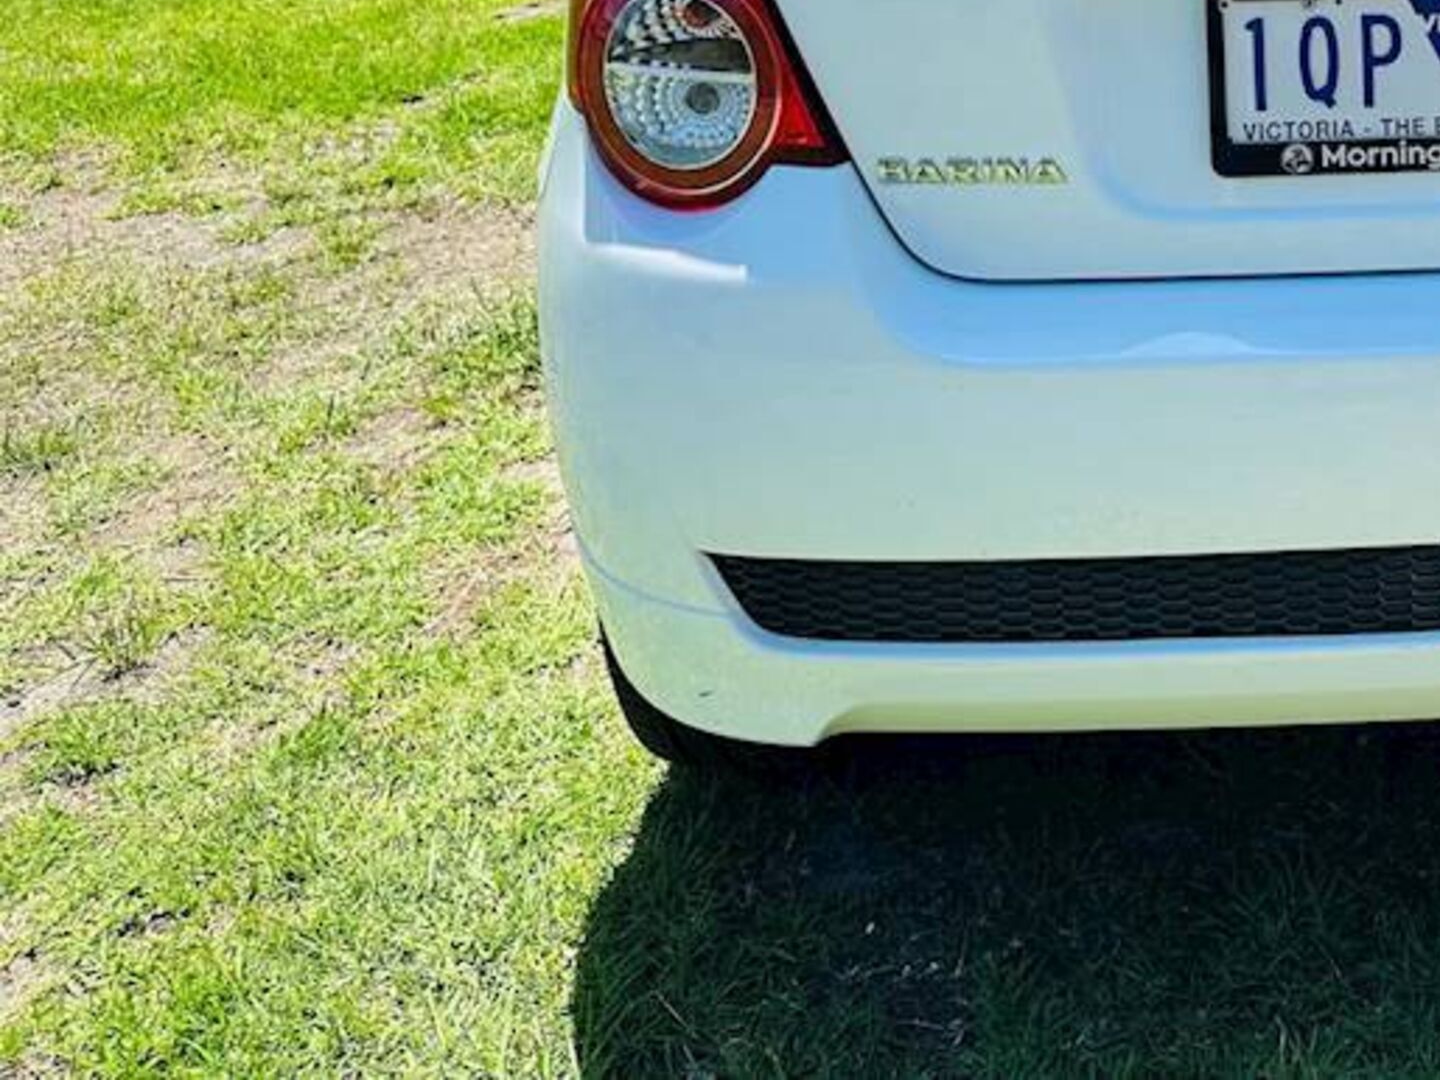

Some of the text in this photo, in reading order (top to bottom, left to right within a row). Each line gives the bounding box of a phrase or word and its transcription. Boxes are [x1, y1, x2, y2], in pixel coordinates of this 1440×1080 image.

[1243, 120, 1354, 140] VICTORIA
[1381, 117, 1425, 136] THE
[878, 158, 1068, 184] BARINA
